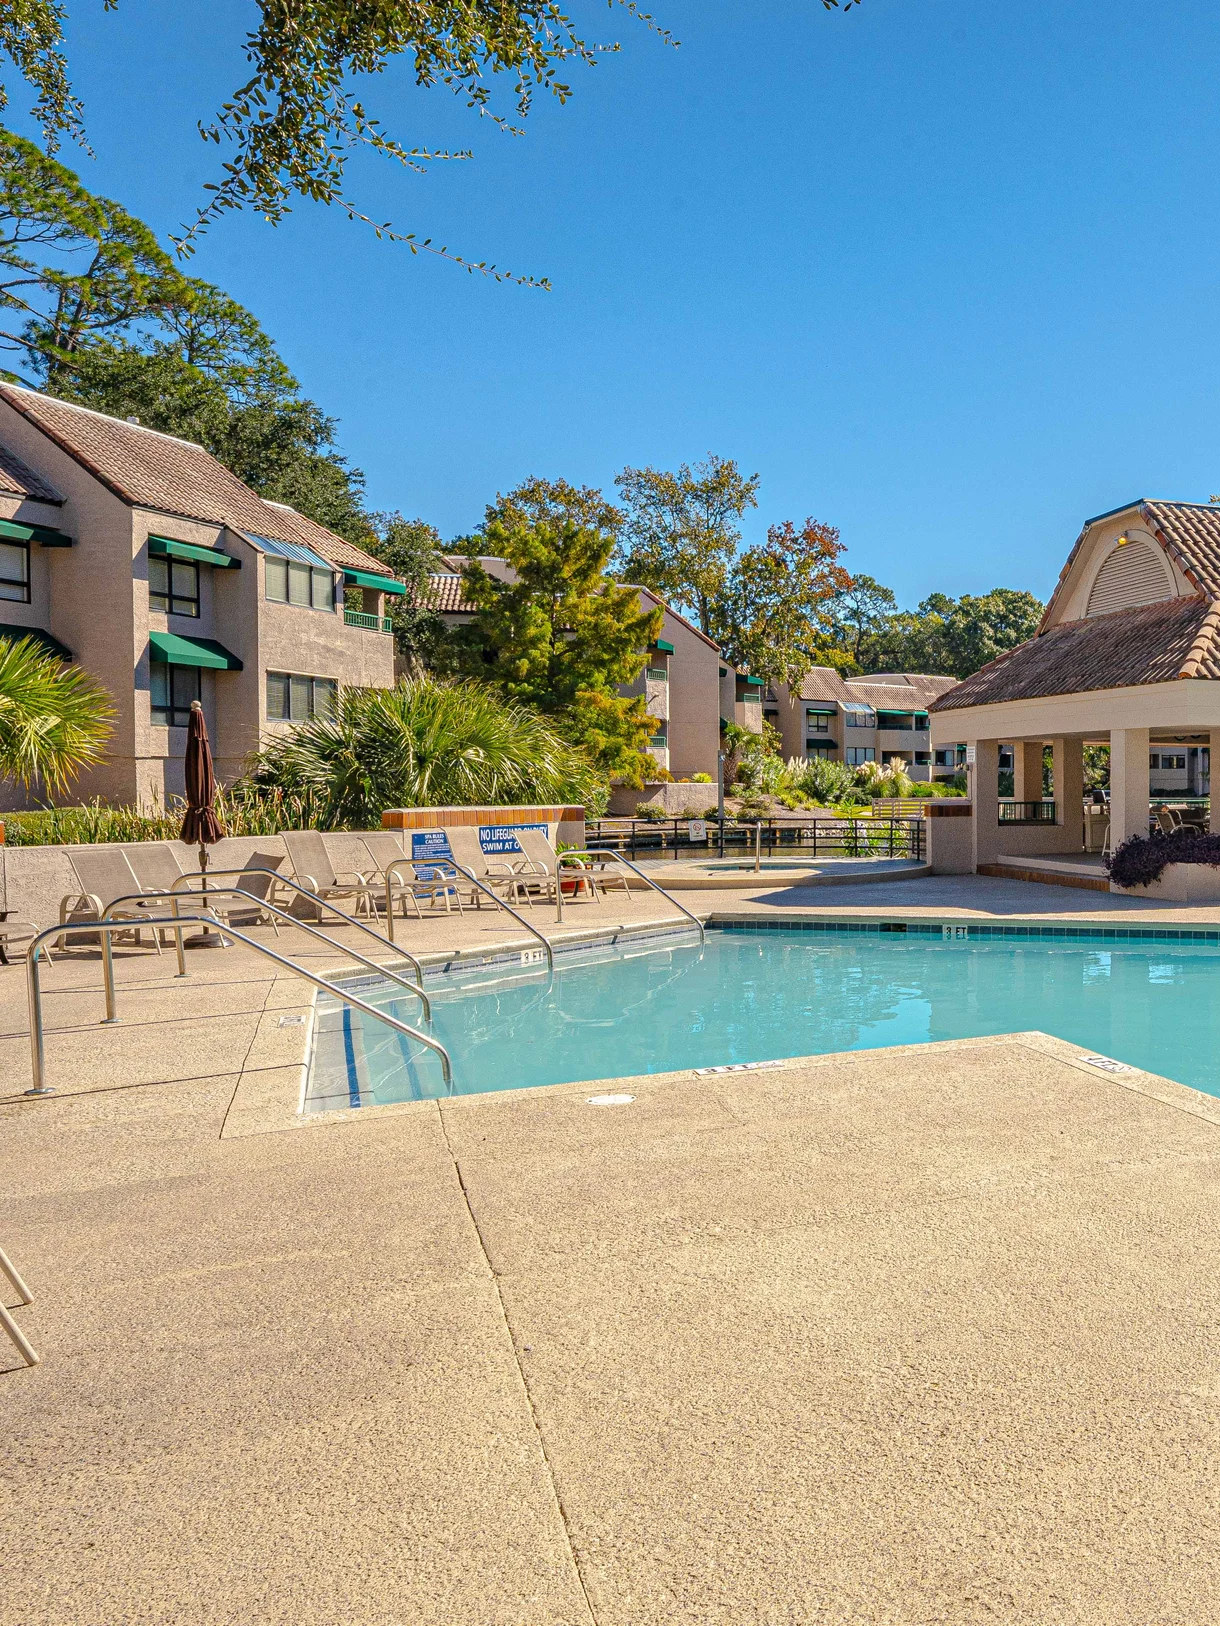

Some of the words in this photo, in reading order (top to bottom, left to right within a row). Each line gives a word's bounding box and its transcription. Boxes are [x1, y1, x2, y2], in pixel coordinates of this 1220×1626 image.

[480, 830, 490, 841] NO
[482, 842, 503, 851] SWIM
[504, 841, 513, 850] AT
